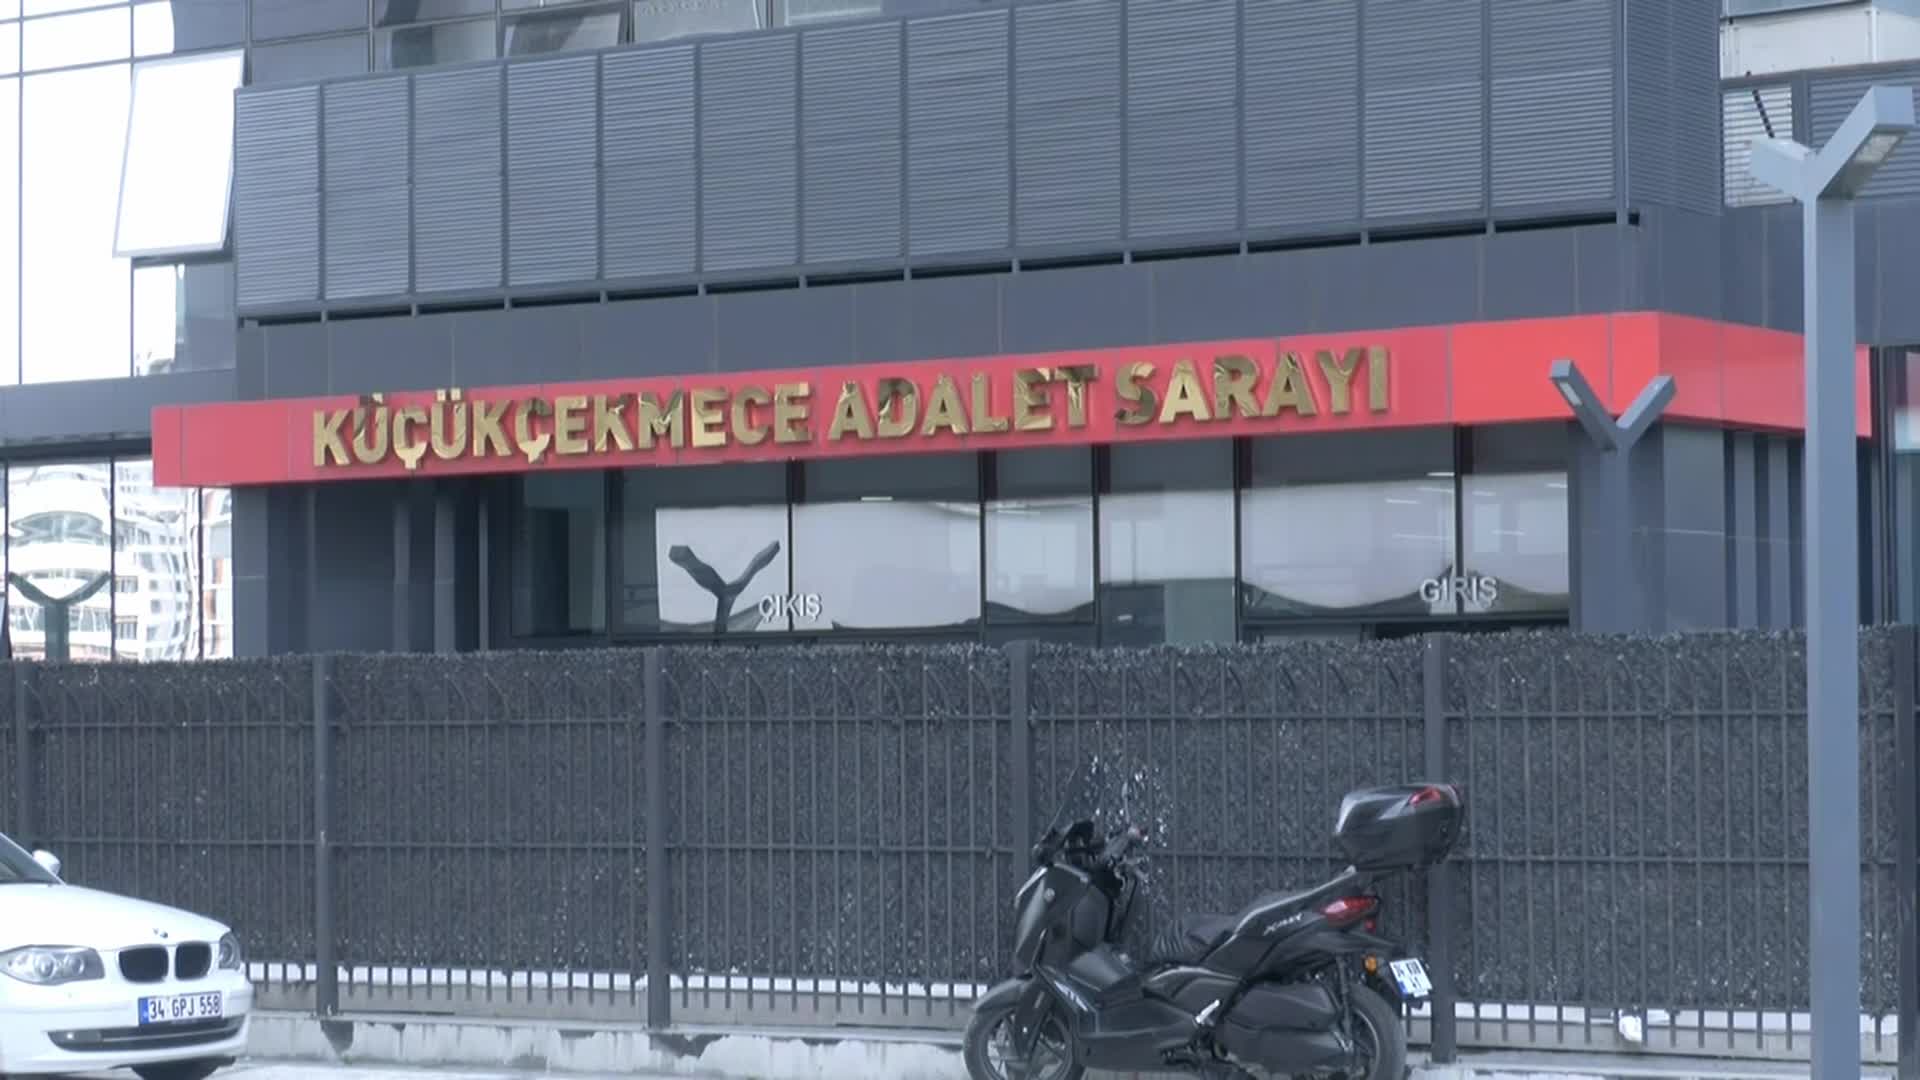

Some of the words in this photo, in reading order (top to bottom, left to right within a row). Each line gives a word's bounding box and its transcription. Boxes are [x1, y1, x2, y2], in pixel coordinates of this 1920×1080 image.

[312, 382, 811, 470] KÜÇÜKÇEKMECE
[828, 363, 1096, 441] ADALET
[1114, 345, 1388, 426] SARAYI
[759, 593, 823, 622] ÇIKIŞ
[149, 1000, 165, 1019] 34
[171, 998, 195, 1018] GPJ
[200, 995, 220, 1015] 558
